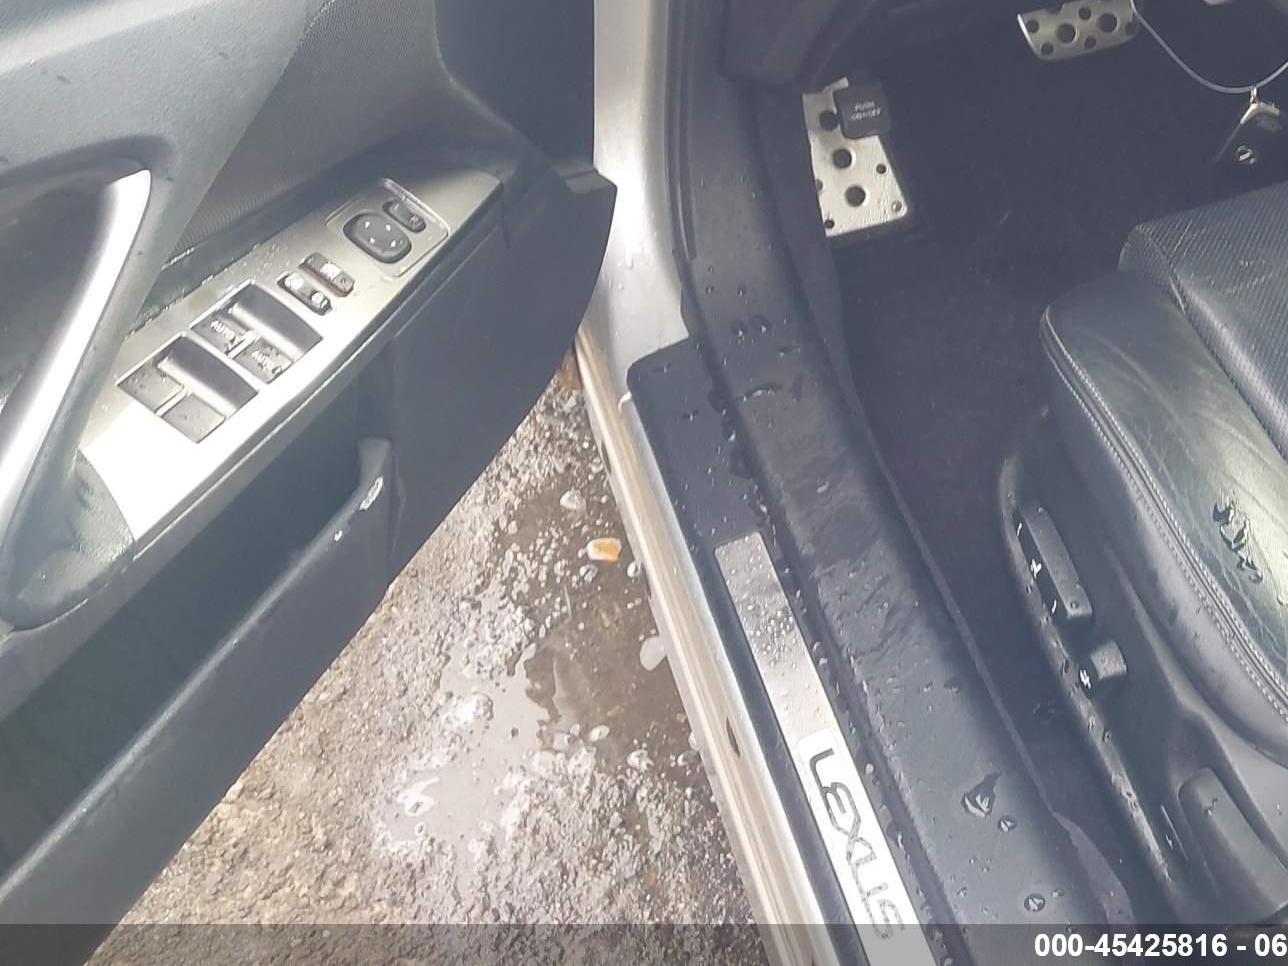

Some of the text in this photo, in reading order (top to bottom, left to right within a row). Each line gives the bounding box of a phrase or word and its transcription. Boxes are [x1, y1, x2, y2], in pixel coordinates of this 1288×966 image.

[854, 100, 875, 112] PUSH
[210, 320, 235, 342] AUTO
[251, 349, 278, 373] AUTO
[809, 747, 905, 941] LEXUS
